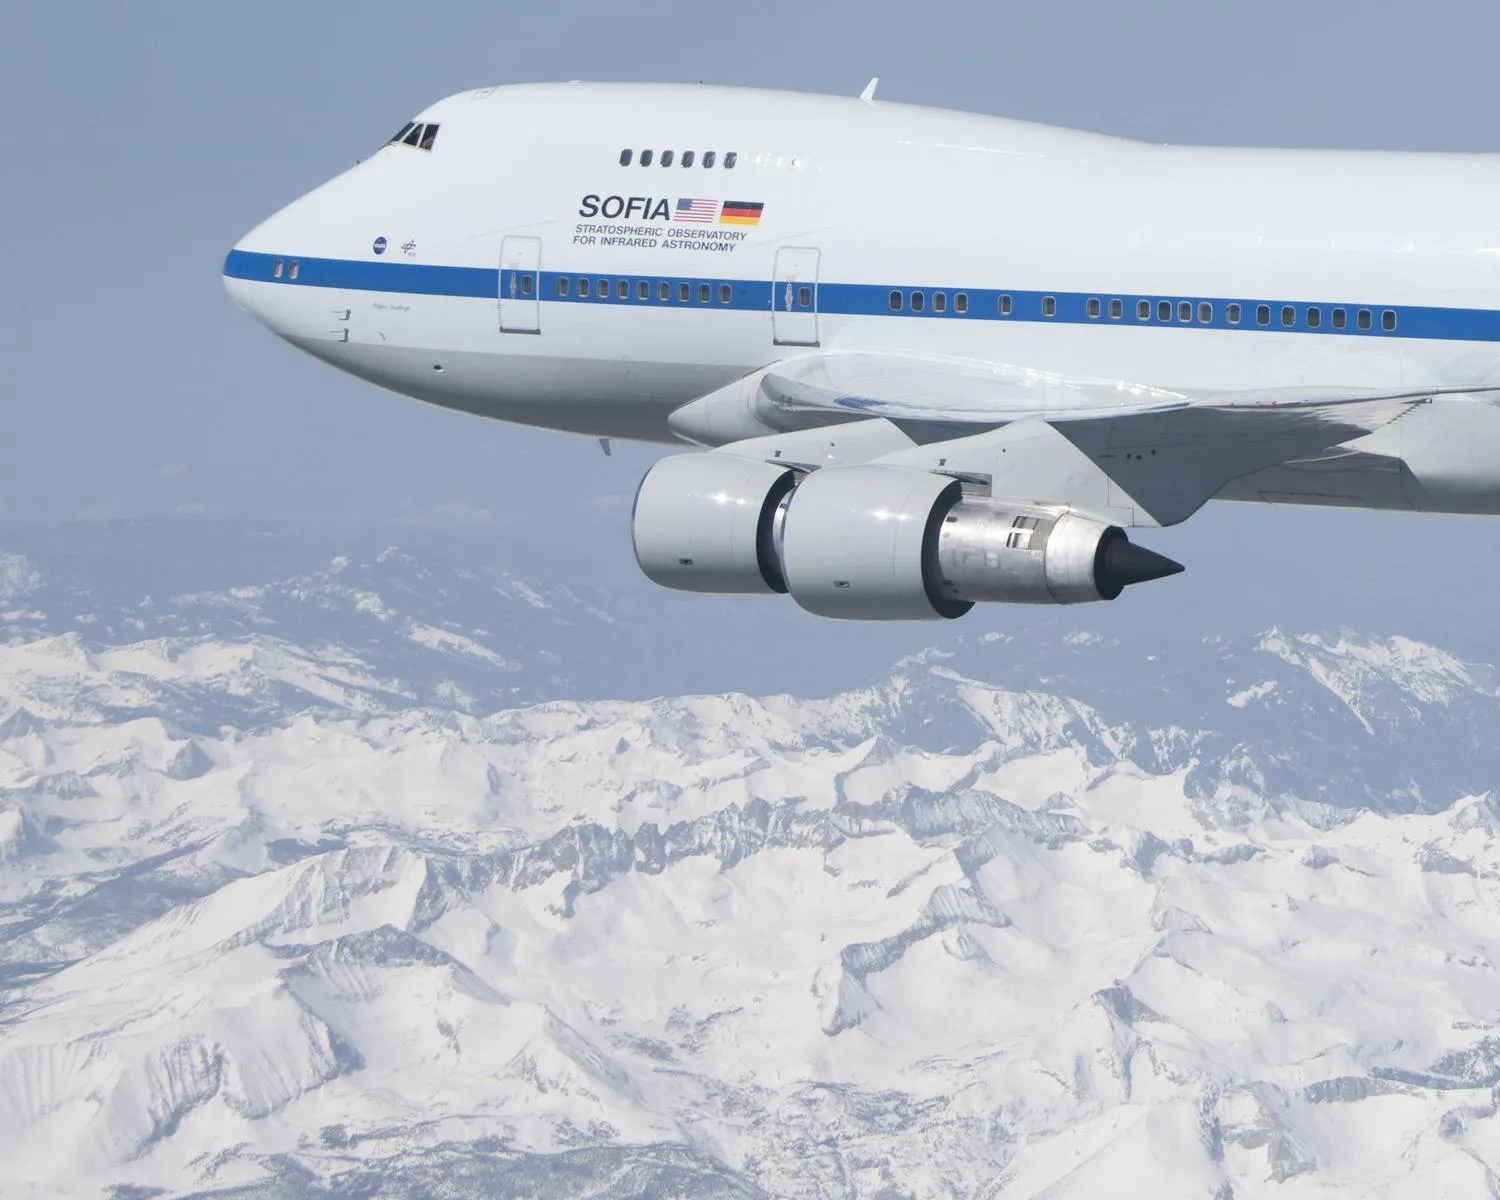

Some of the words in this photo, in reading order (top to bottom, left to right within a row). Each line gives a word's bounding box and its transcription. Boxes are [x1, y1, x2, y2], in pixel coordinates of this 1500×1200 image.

[579, 194, 670, 220] SOFIA
[575, 224, 663, 237] STRATOSPHERIC
[667, 228, 747, 241] OBSERVATORY
[573, 236, 596, 245] FOR
[600, 237, 657, 248] INFRARED
[661, 241, 736, 252] ASTRONOMY
